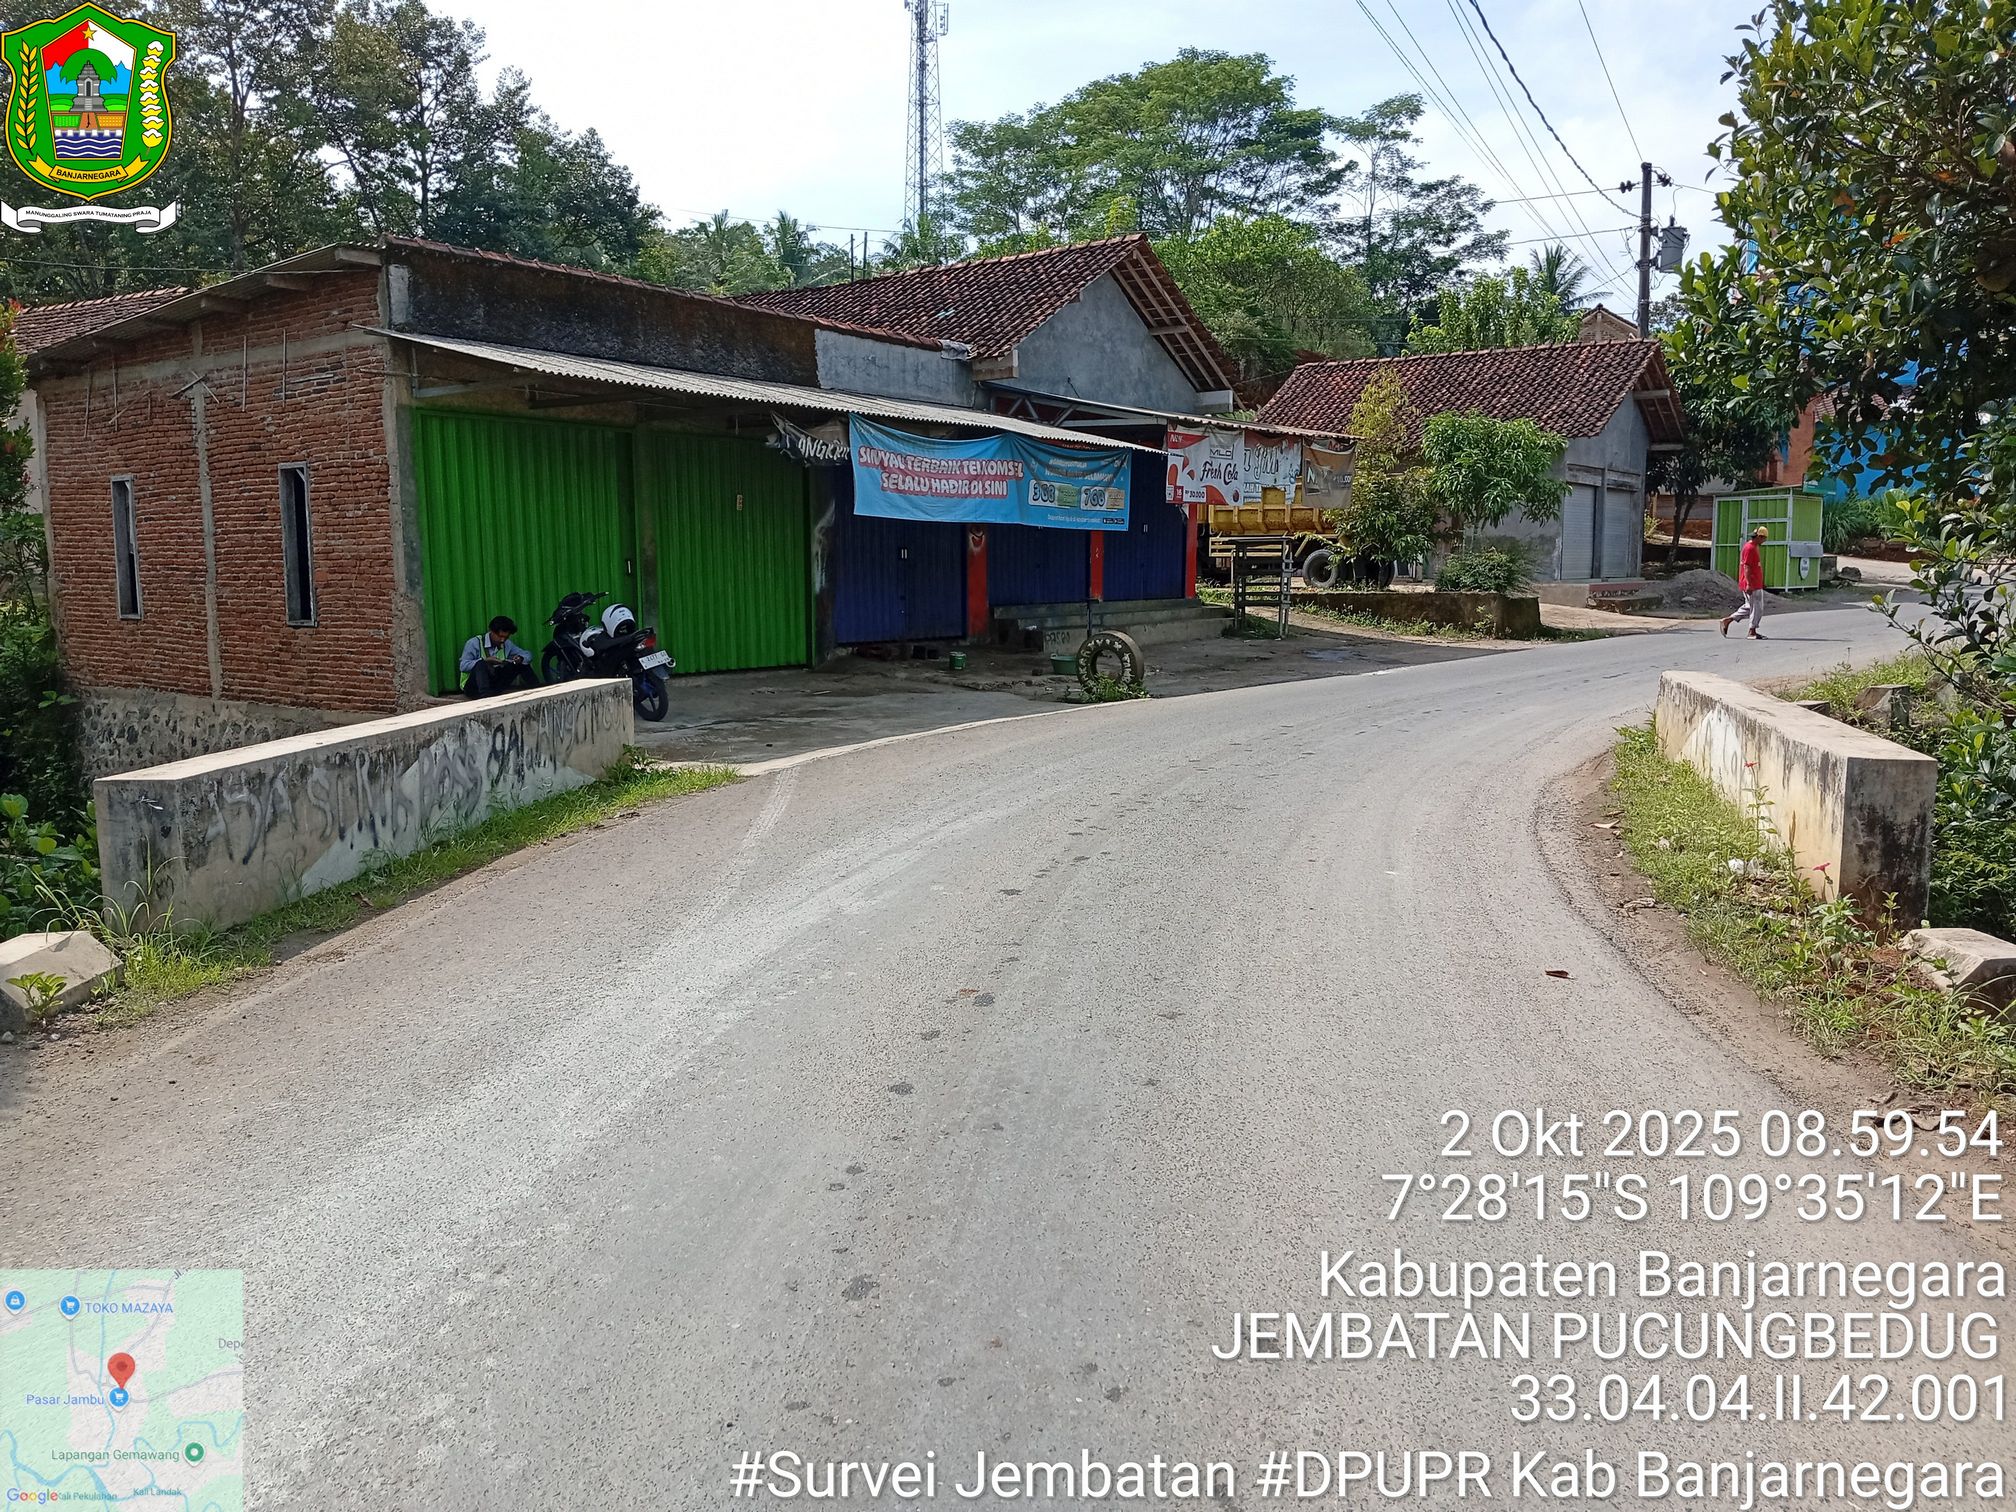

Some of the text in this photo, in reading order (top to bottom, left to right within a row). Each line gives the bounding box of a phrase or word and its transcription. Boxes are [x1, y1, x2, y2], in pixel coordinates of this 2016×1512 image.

[858, 446, 906, 470] SINYAL
[905, 455, 962, 475] TERBAIK
[1200, 460, 1222, 482] Fresh
[1223, 462, 1239, 486] Cola
[880, 472, 1008, 497] SELALU HADIR DI SINI
